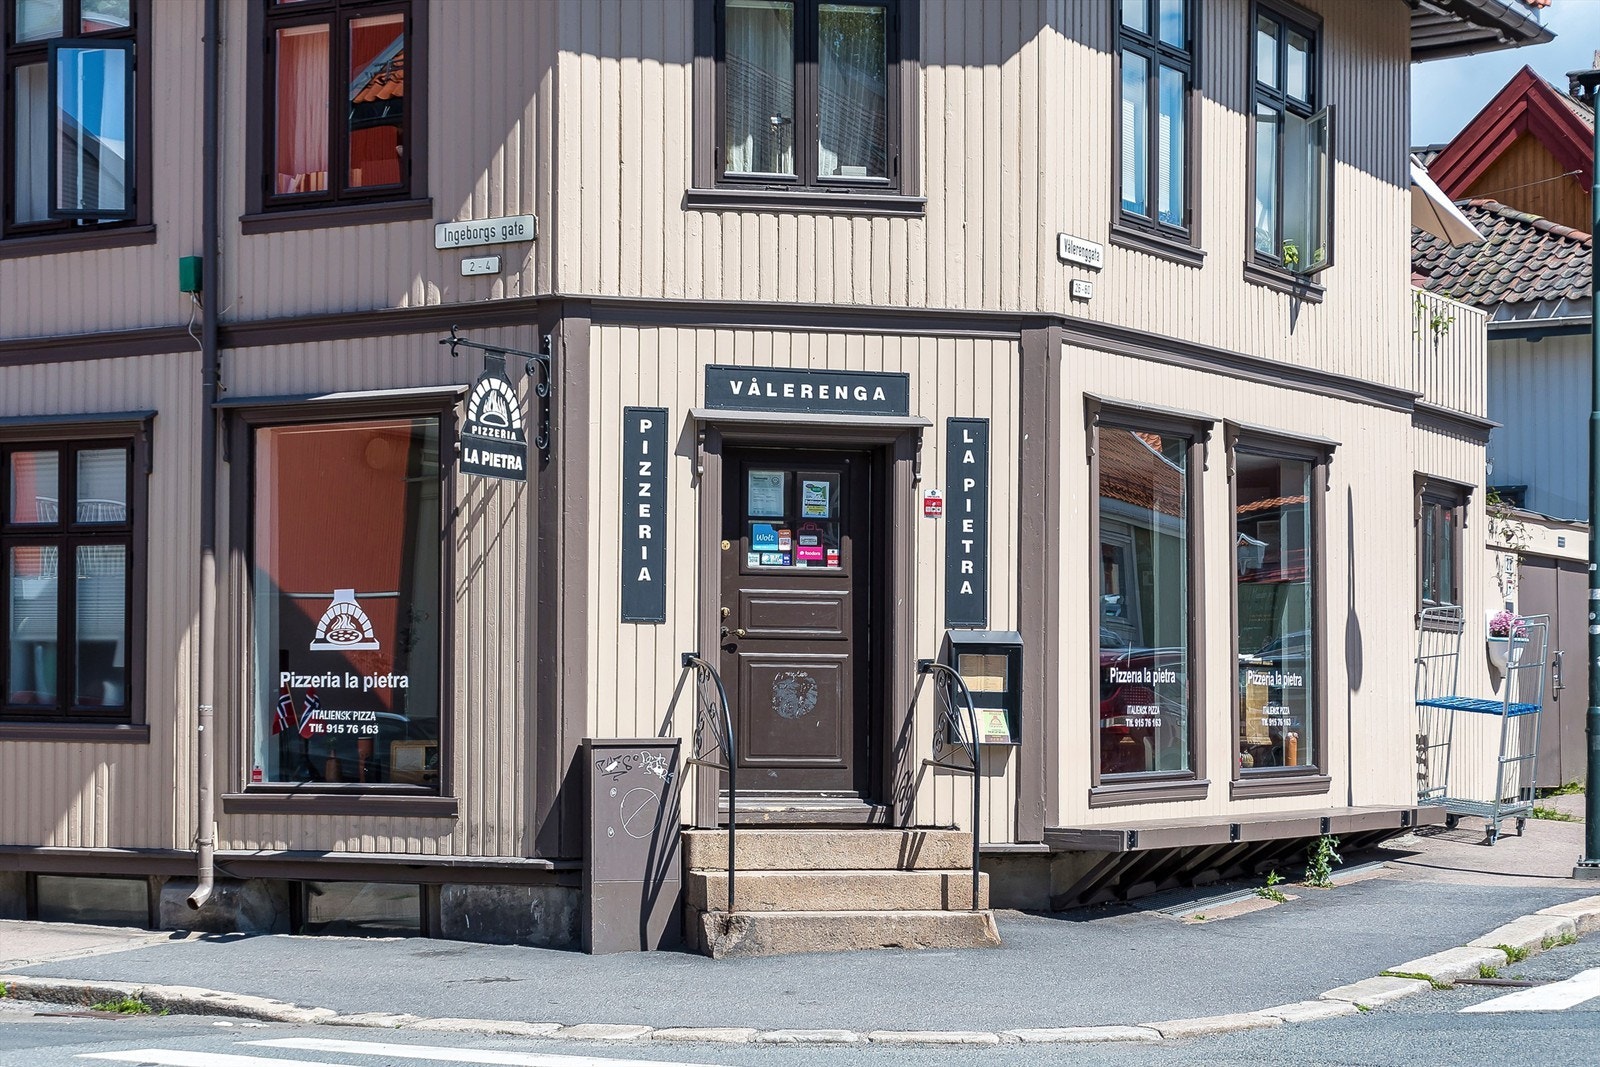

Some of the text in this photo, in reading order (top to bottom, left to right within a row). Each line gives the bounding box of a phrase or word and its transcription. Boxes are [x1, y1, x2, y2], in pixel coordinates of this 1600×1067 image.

[444, 221, 524, 246] Ingeborgs gate
[1063, 237, 1100, 263] Vålerenggata
[470, 262, 475, 272] 2
[485, 261, 490, 271] 4
[729, 377, 886, 401] VÅLERENGA
[471, 425, 516, 441] PIZZERIA
[464, 447, 523, 471] LA PIETRA
[638, 419, 653, 582] PIZZERIA
[960, 429, 976, 595] LA PIETRA
[756, 533, 775, 542] Wolt
[280, 671, 409, 692] Pizzeria la pietra
[1110, 667, 1176, 687] Pizzeria la pietra
[1247, 670, 1302, 689] Pizzeria la pietra
[311, 709, 377, 721] ITALIENSK PIZZA
[1148, 706, 1160, 715] PIZZA
[309, 723, 379, 735] Tlf. 915 76 163
[1135, 718, 1144, 727] 915
[1145, 718, 1151, 727] 76
[1152, 718, 1161, 728] 163
